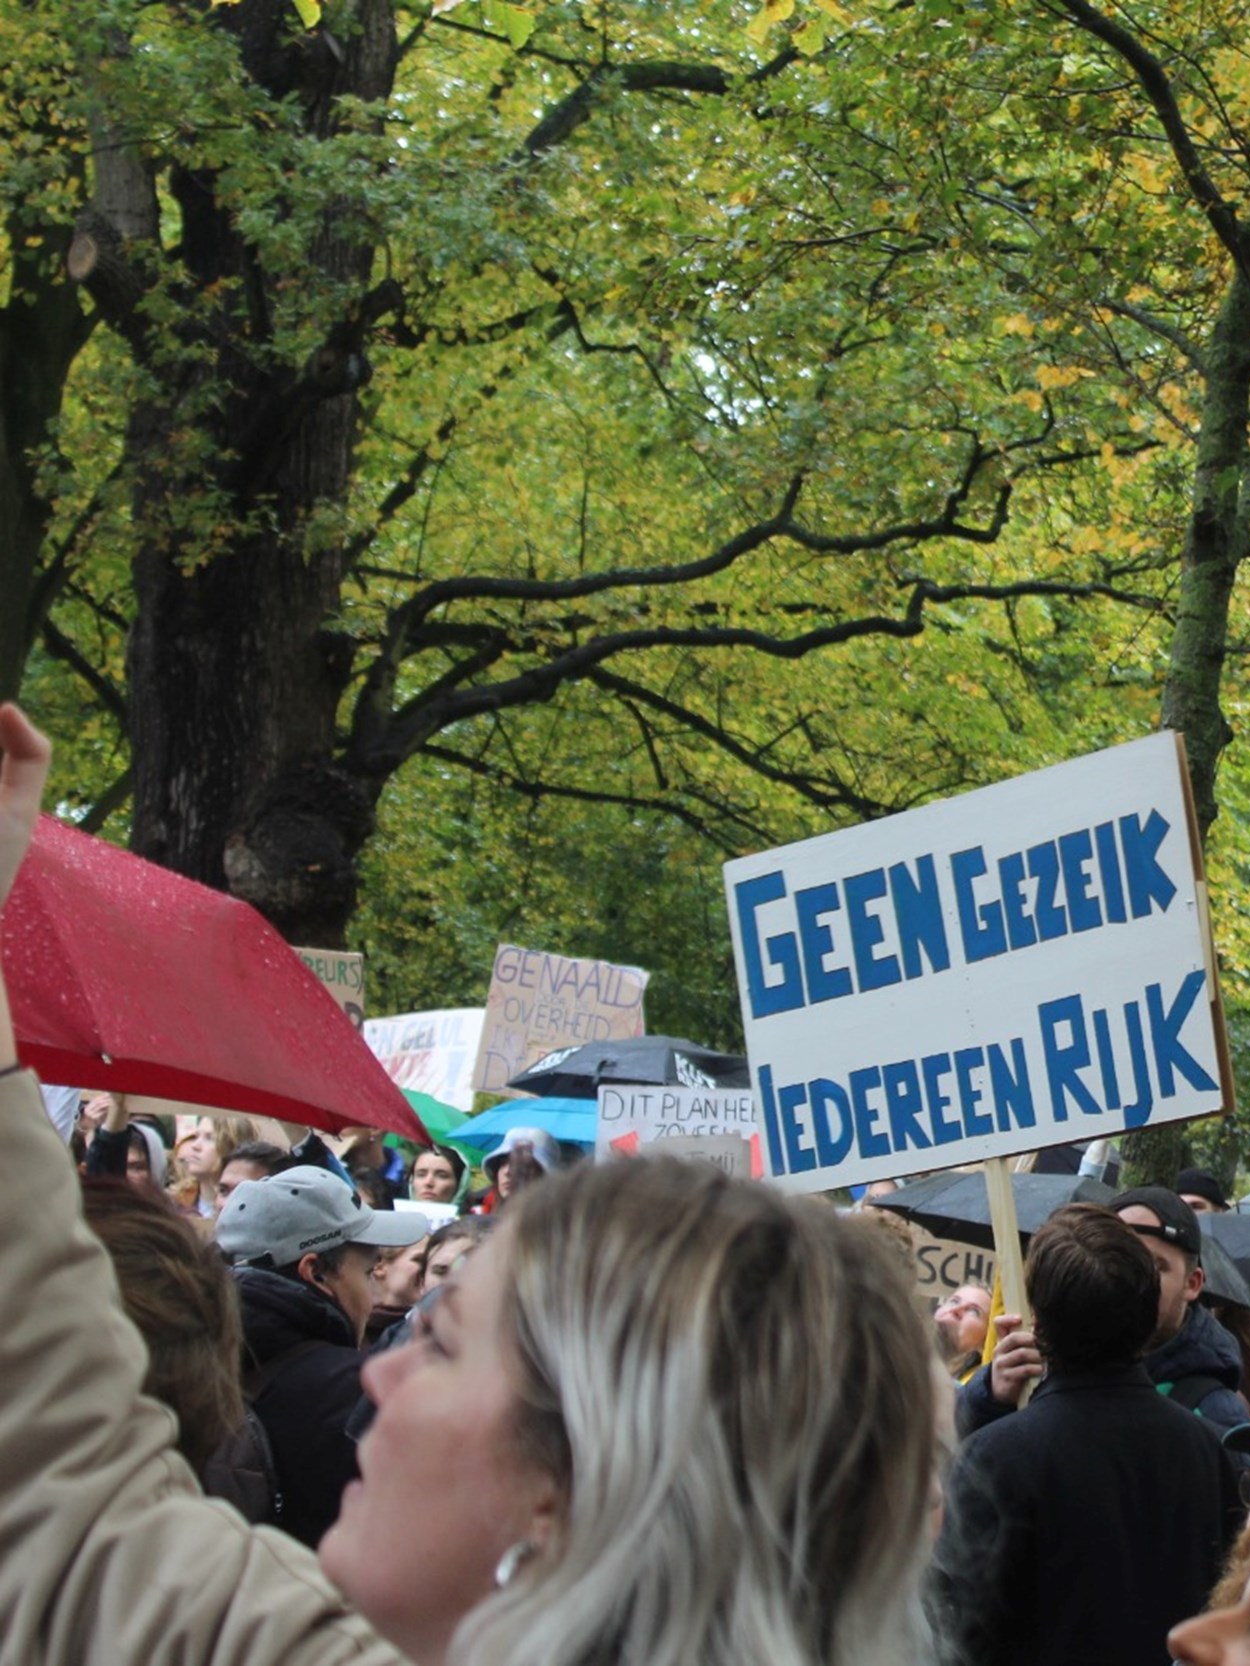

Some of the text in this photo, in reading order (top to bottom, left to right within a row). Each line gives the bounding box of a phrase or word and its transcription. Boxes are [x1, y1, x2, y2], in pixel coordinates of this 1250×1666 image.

[734, 808, 1177, 1019] GEEN GEZEIK
[494, 947, 644, 1009] GENAAID
[503, 997, 612, 1042] OVERHEID
[757, 970, 1220, 1177] IEDEREEN RIJK
[602, 1090, 653, 1121] DIT
[661, 1093, 719, 1122] PLAN
[299, 1229, 342, 1250] DOOSAN
